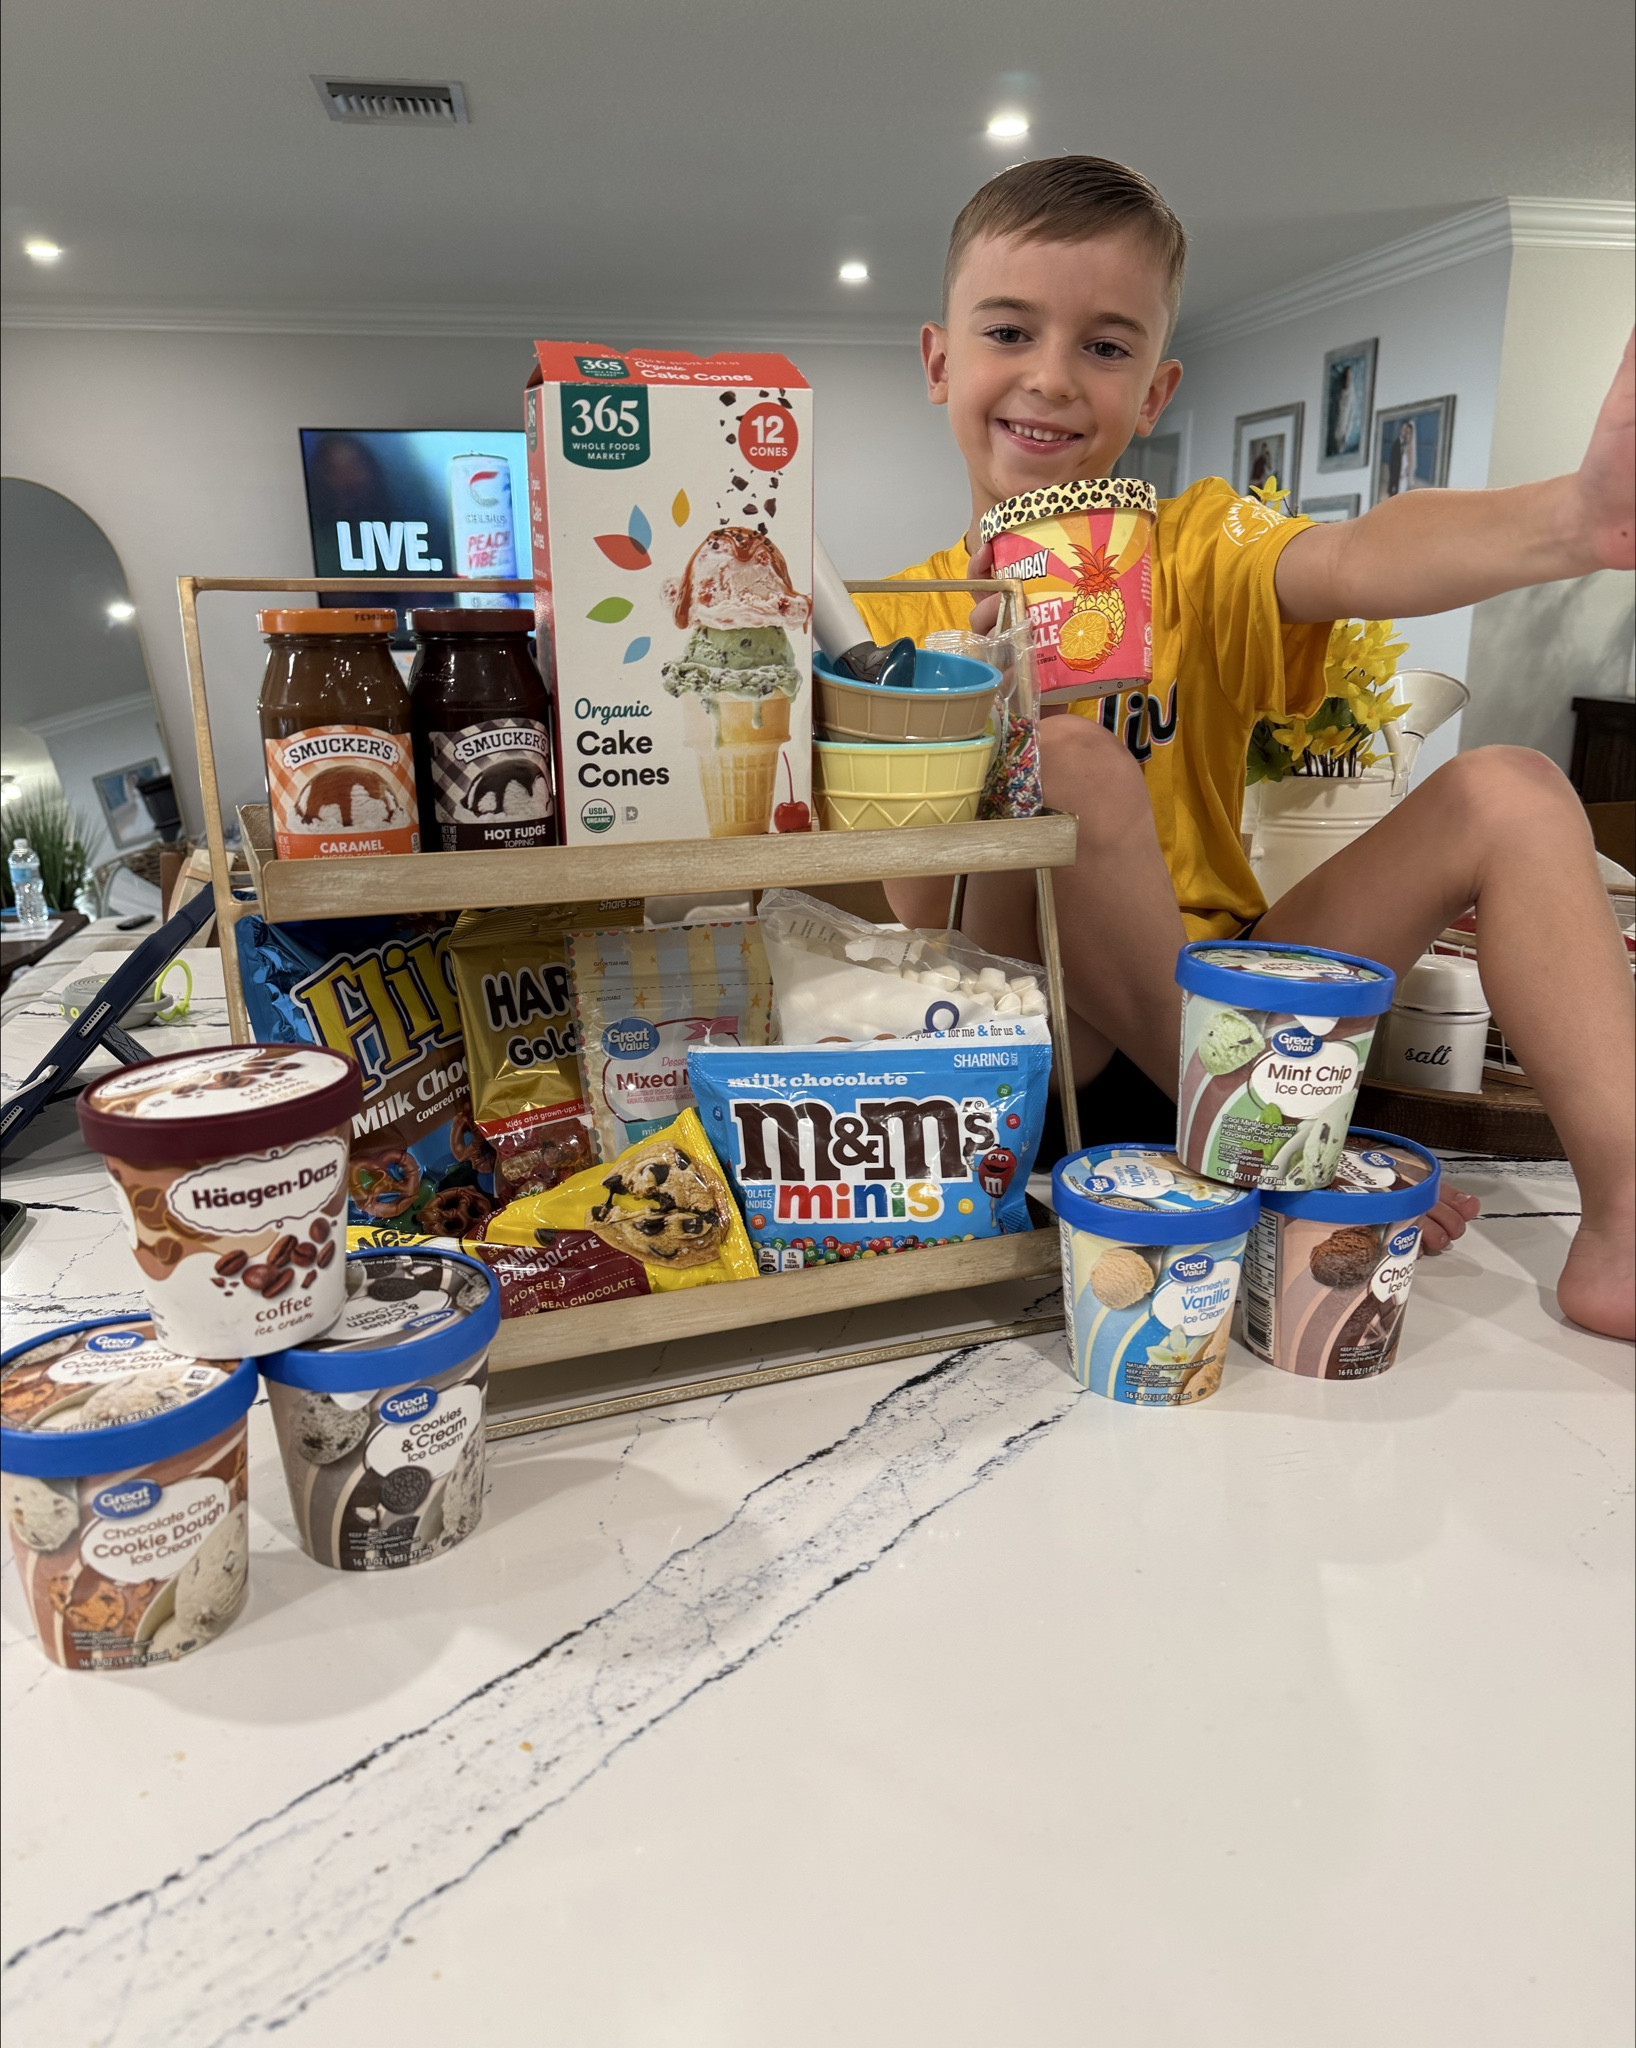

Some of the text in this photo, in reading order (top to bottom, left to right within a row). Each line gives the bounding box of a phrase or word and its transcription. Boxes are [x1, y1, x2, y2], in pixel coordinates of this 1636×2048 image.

[582, 359, 622, 371] 365
[635, 361, 686, 372] Organic
[641, 370, 753, 381] Cake Cones
[571, 395, 640, 438] 365
[751, 415, 785, 444] 12
[609, 443, 640, 451] FOODS
[749, 447, 788, 457] CONES
[1227, 502, 1246, 538] MIAMI
[336, 521, 443, 571] LIVE.
[468, 531, 510, 552] PEACH
[1003, 549, 1050, 580] BOMBAY
[1026, 599, 1062, 626] BET
[574, 698, 652, 725] Organic
[288, 737, 393, 765] SMUCKER'S
[462, 732, 547, 758] SMUCKER'S
[577, 730, 653, 756] Cake
[578, 763, 670, 788] Cones
[588, 807, 608, 815] USDA
[484, 824, 546, 840] HOT FUDGE
[320, 839, 384, 853] CARAMEL
[504, 838, 534, 848] TOPPING
[600, 899, 626, 911] Share
[607, 1029, 649, 1045] Great
[963, 1028, 975, 1037] me
[977, 1025, 988, 1037] &
[990, 1025, 1002, 1036] for
[1004, 1026, 1014, 1035] us
[1015, 1025, 1026, 1036] &
[1278, 1033, 1315, 1046] Great
[508, 1023, 577, 1066] Gold
[618, 1039, 650, 1052] Value
[1286, 1043, 1314, 1052] Value
[954, 1052, 1009, 1068] SHARING
[1405, 1045, 1452, 1065] salt
[616, 1070, 677, 1090] Mixed
[728, 1072, 908, 1088] milk chocolate
[1268, 1063, 1352, 1083] Mint Chip
[240, 1076, 298, 1096] coffee
[1275, 1082, 1342, 1096] Ice Cream
[350, 1090, 415, 1140] Milk
[416, 1092, 454, 1122] Covered
[505, 1119, 522, 1129] Kids
[524, 1113, 538, 1123] and
[540, 1106, 577, 1120] grown-ups
[1222, 1114, 1240, 1123] Cool
[1272, 1123, 1297, 1131] Cream
[1221, 1129, 1273, 1144] Flavored Chips
[1222, 1122, 1292, 1138] with Rich Chocolate
[1217, 1168, 1225, 1176] 16
[1226, 1170, 1234, 1178] FL
[1235, 1172, 1243, 1180] OZ
[984, 1176, 1003, 1195] m
[777, 1182, 942, 1220] minis
[1394, 1232, 1415, 1246] Great
[1399, 1241, 1414, 1250] Value
[496, 1246, 538, 1273] DARK
[500, 1235, 600, 1286] CHOCOLATE
[1175, 1259, 1208, 1273] Great
[1182, 1267, 1207, 1277] Value
[509, 1279, 565, 1306] MORSELS
[541, 1301, 568, 1309] REAL
[570, 1277, 637, 1305] CHOCOLATE
[1186, 1278, 1230, 1295] Homestyle
[1181, 1289, 1230, 1310] Vanilla
[255, 1296, 312, 1323] coffee
[347, 1308, 407, 1328] Cream
[1183, 1308, 1225, 1324] Ice Cream
[255, 1310, 314, 1336] ice cream
[361, 1311, 418, 1330] Cookies
[96, 1336, 137, 1345] Great
[62, 1359, 125, 1369] Cookie
[102, 1362, 163, 1373] Cream
[387, 1392, 429, 1411] Great
[397, 1403, 429, 1418] Value
[409, 1407, 462, 1436] Cookies
[402, 1418, 467, 1452] & Cream
[408, 1433, 464, 1463] Ice Cream
[101, 1487, 150, 1507] Great
[113, 1498, 152, 1514] Value
[103, 1493, 217, 1541] Chocolate Chip
[93, 1503, 226, 1559] Cookie Dough
[130, 1532, 203, 1566] Ice Cream
